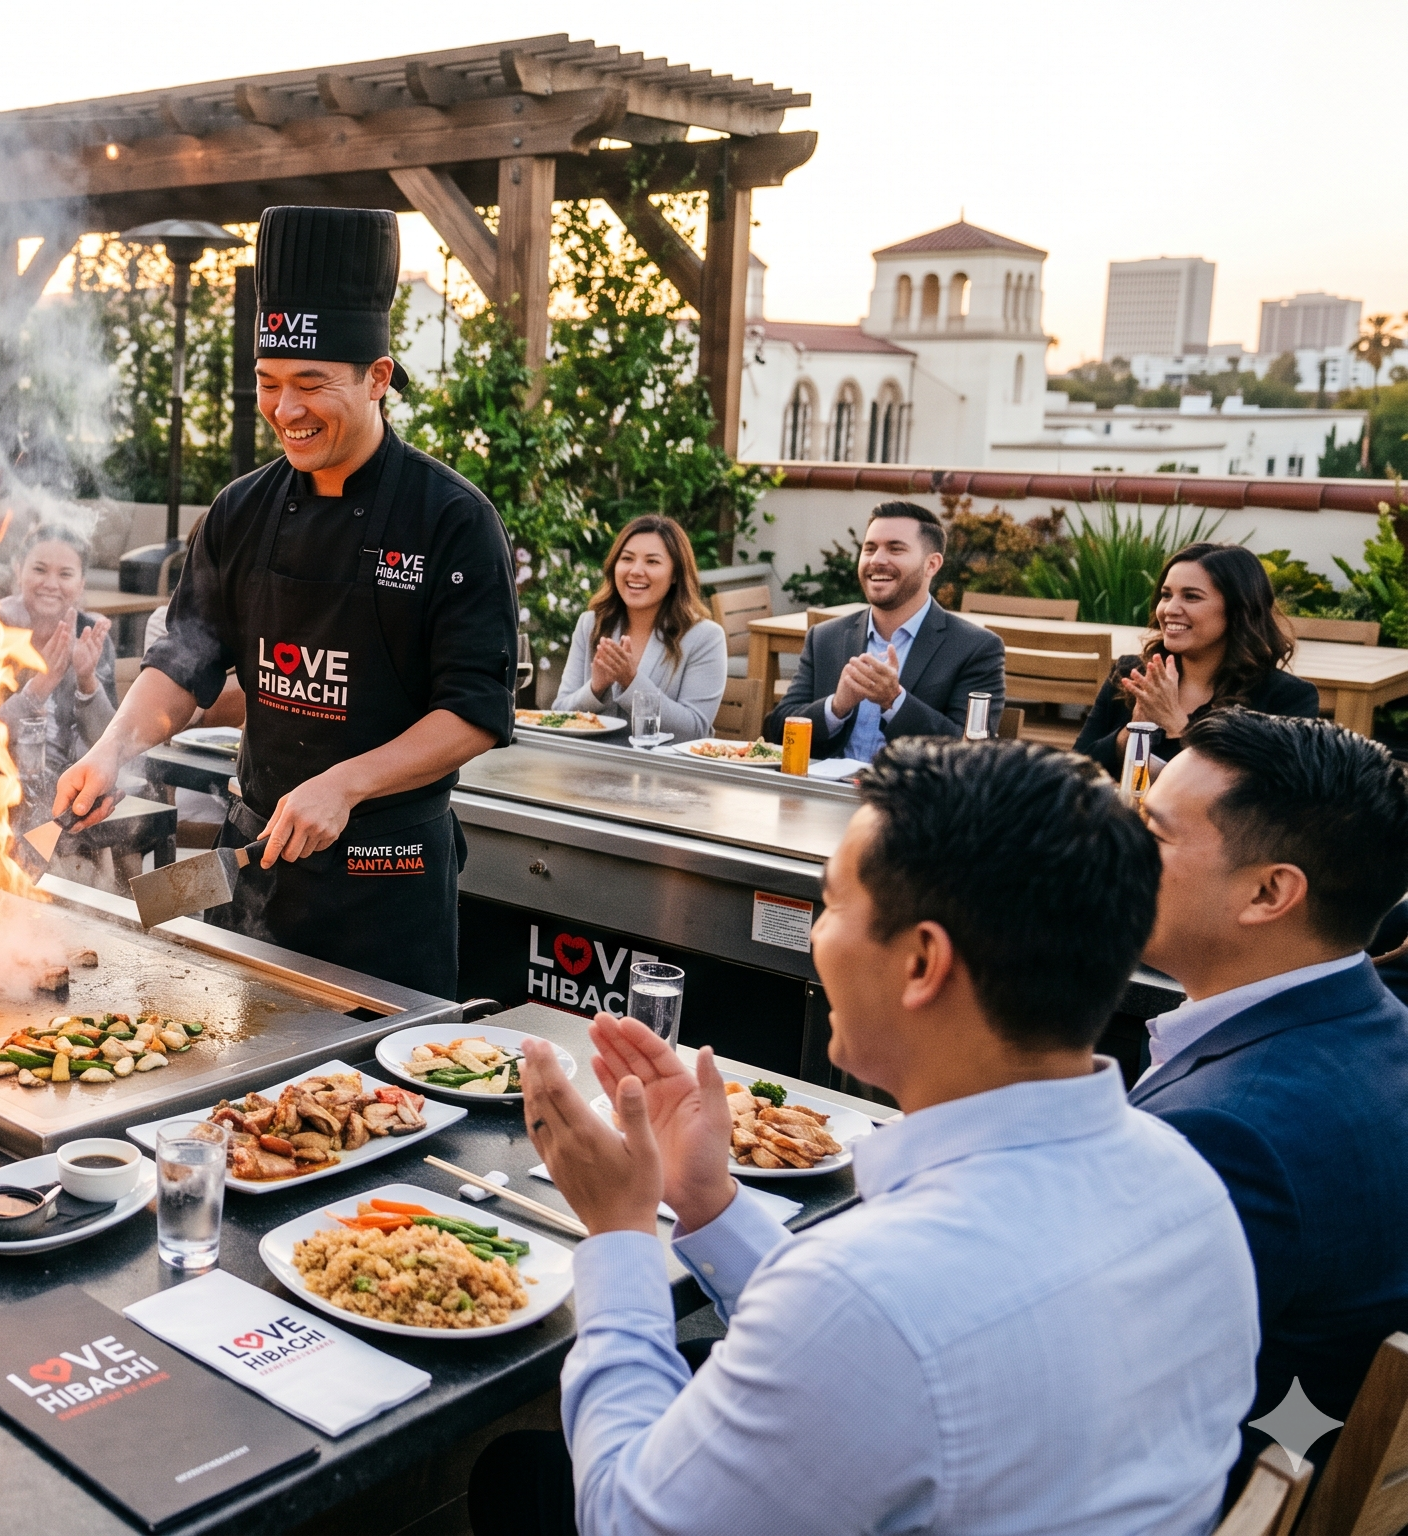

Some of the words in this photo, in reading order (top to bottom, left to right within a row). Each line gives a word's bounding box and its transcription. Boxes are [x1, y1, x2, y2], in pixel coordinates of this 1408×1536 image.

[258, 334, 317, 350] HIBACHI
[375, 566, 423, 583] HIBACHI
[258, 670, 347, 706] HIBACHI
[347, 845, 392, 857] PRIVATE
[395, 843, 423, 856] CHEF
[347, 858, 393, 871] SANTA
[395, 857, 425, 870] ANA
[528, 968, 626, 1019] HIBAC
[242, 1329, 326, 1371] HIBACHI
[36, 1356, 160, 1414] HIBACHI
